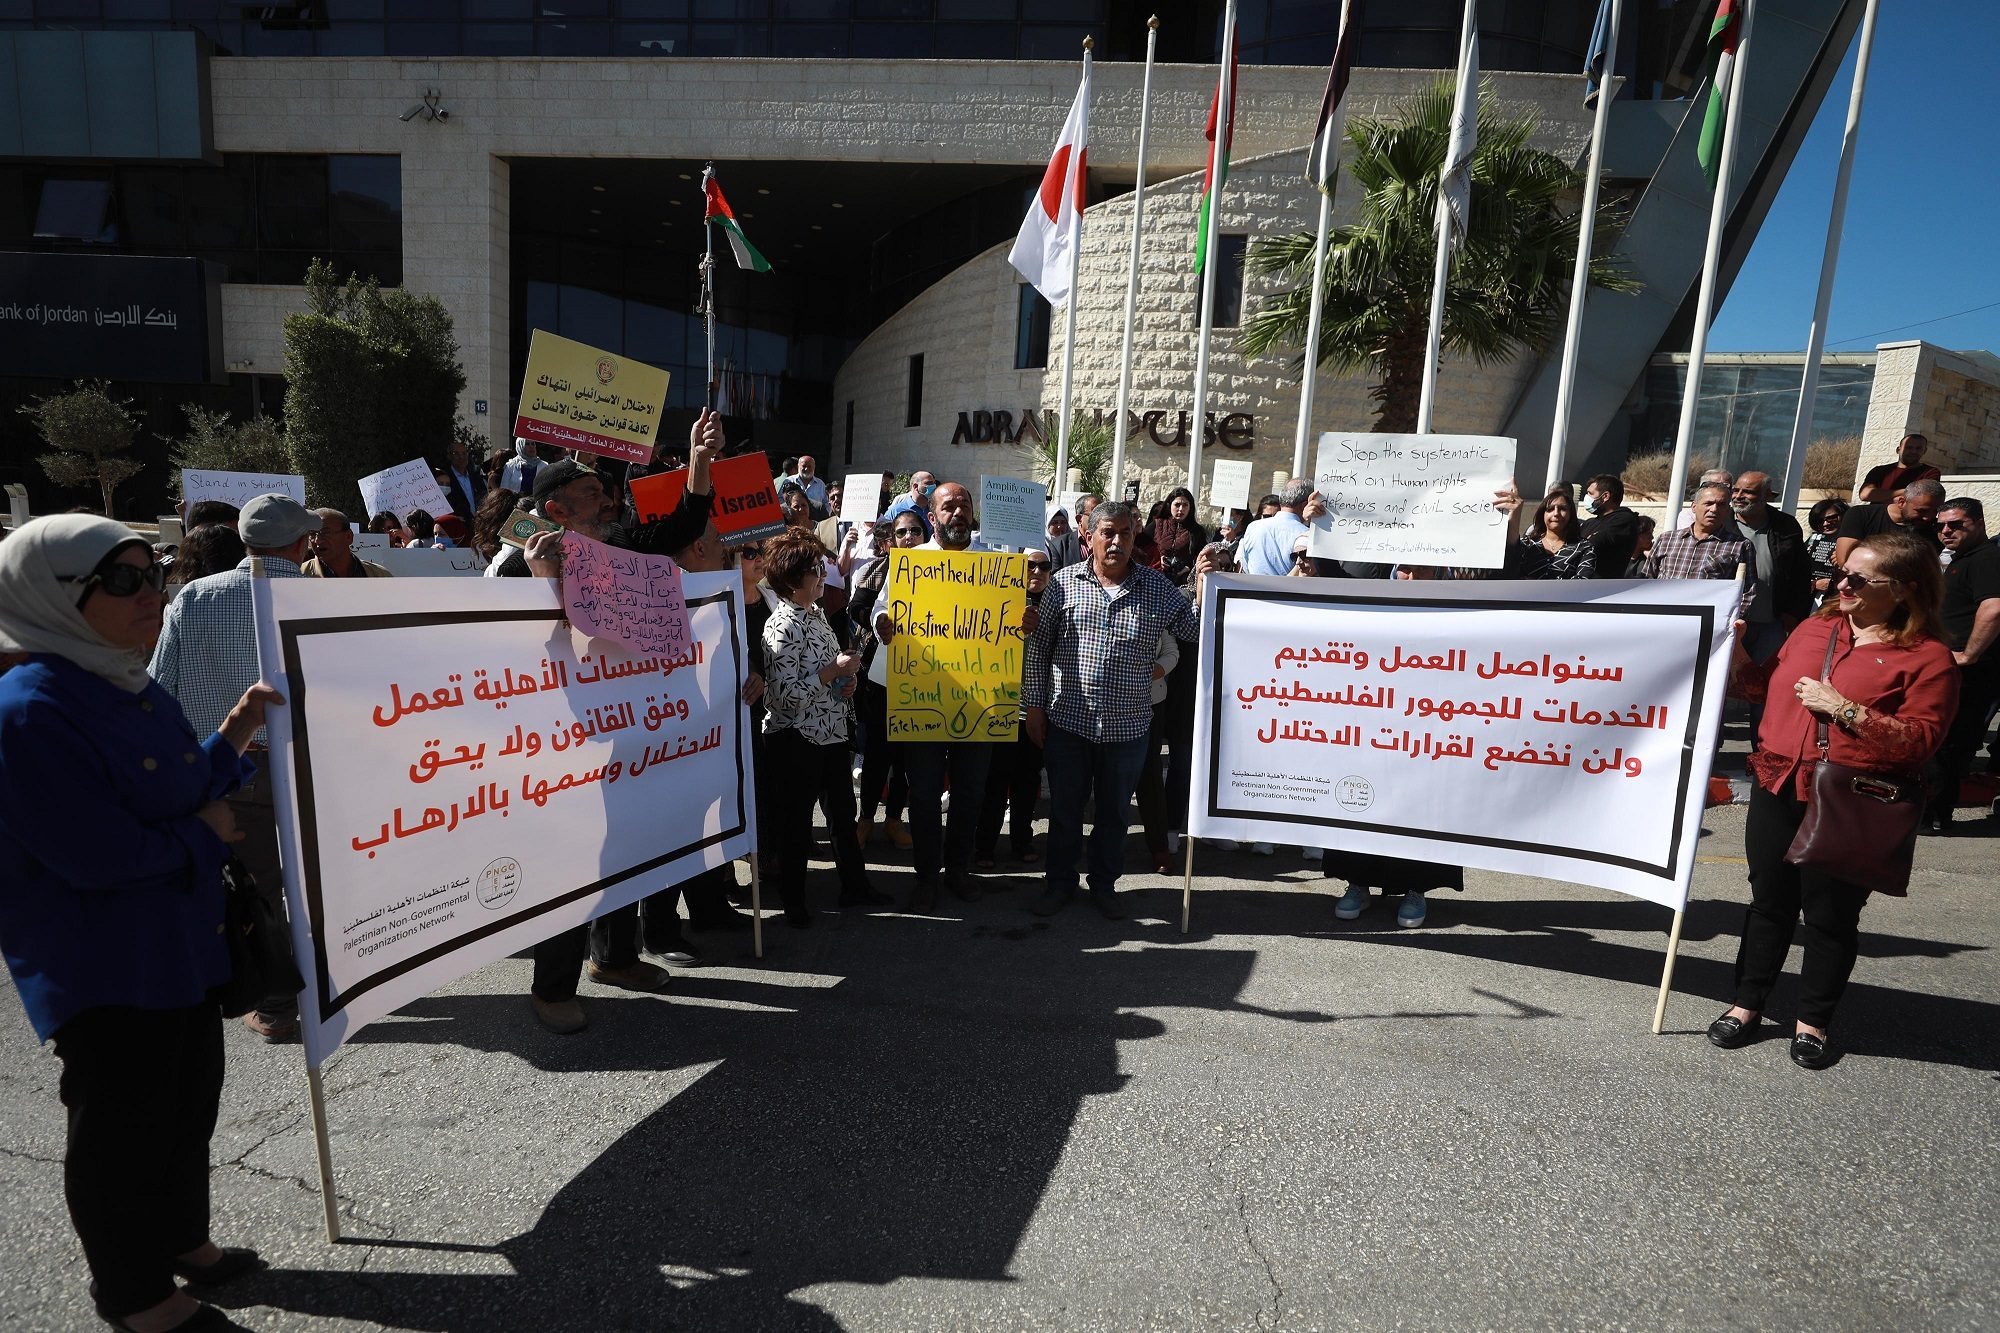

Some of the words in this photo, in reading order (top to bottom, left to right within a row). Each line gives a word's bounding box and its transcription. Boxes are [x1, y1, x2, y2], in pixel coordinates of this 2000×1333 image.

[0, 302, 23, 320] ank
[26, 304, 40, 320] of
[42, 305, 88, 325] Jordan
[145, 308, 177, 330] بنك
[537, 374, 571, 392] انتهاك
[476, 403, 486, 411] 15
[532, 398, 570, 415] الانسان
[570, 405, 597, 421] حقوق
[622, 400, 655, 415] الاحتلال
[600, 415, 627, 431] قوانين
[628, 421, 649, 435] لكافة
[1337, 440, 1378, 468] Stop
[1383, 441, 1403, 459] the
[1410, 442, 1489, 471] systematic
[189, 474, 229, 489] Stand
[251, 479, 292, 496] Solidarity
[986, 481, 1019, 494] Amplify
[1020, 486, 1034, 494] our
[1321, 469, 1358, 486] attack
[1365, 476, 1385, 487] on
[1392, 473, 1428, 487] Human
[1433, 472, 1467, 493] rights
[721, 487, 774, 515] Israel
[986, 492, 1025, 504] demands
[1384, 503, 1405, 514] and
[725, 532, 743, 543] Society
[752, 523, 785, 535] Development
[1338, 518, 1415, 535] organization
[896, 555, 975, 594] Apartheid
[979, 556, 1002, 587] Will
[1000, 557, 1025, 589] End
[891, 600, 950, 639] Palestine
[953, 605, 979, 640] Will
[980, 608, 993, 642] Be
[995, 600, 1025, 646] Free
[893, 645, 918, 676] We
[921, 645, 983, 676] Should
[990, 648, 1015, 675] all
[1274, 641, 1370, 670] وتقديم
[1379, 646, 1466, 673] العمل
[1477, 651, 1623, 683] سنواصل
[473, 658, 568, 710] الأهلية
[900, 681, 942, 705] Stand
[952, 681, 986, 701] with
[991, 682, 1019, 700] the
[1236, 678, 1395, 711] الفلسطيني
[373, 674, 465, 728] تعمل
[643, 693, 690, 731] وفق
[1404, 694, 1522, 724] للجمهور
[1533, 698, 1668, 730] الخدمات
[551, 701, 636, 752] القانون
[1257, 718, 1361, 747] الاحتلال
[499, 724, 542, 758] ولا
[1370, 727, 1474, 761] لقرارات
[1483, 741, 1571, 770] نخضع
[1582, 746, 1643, 777] ولن
[521, 756, 622, 807] وسمها
[1231, 769, 1266, 778] الفلسطينية
[1231, 781, 1266, 790] Palestinian
[1267, 772, 1287, 780] الأهلية
[1288, 773, 1314, 782] المنظمات
[1315, 775, 1331, 784] شبكة
[1243, 790, 1288, 801] Organizations
[1289, 794, 1317, 803] Network
[486, 863, 515, 878] PNGO
[416, 884, 449, 902] المنظمات
[451, 877, 470, 889] شبكة
[387, 896, 415, 914] الأهلية
[343, 908, 386, 935] الفلسطينية
[343, 926, 387, 952] Palestinian
[389, 892, 470, 930] Non-Governmental
[357, 927, 417, 958] Organizations
[419, 910, 455, 933] Network
